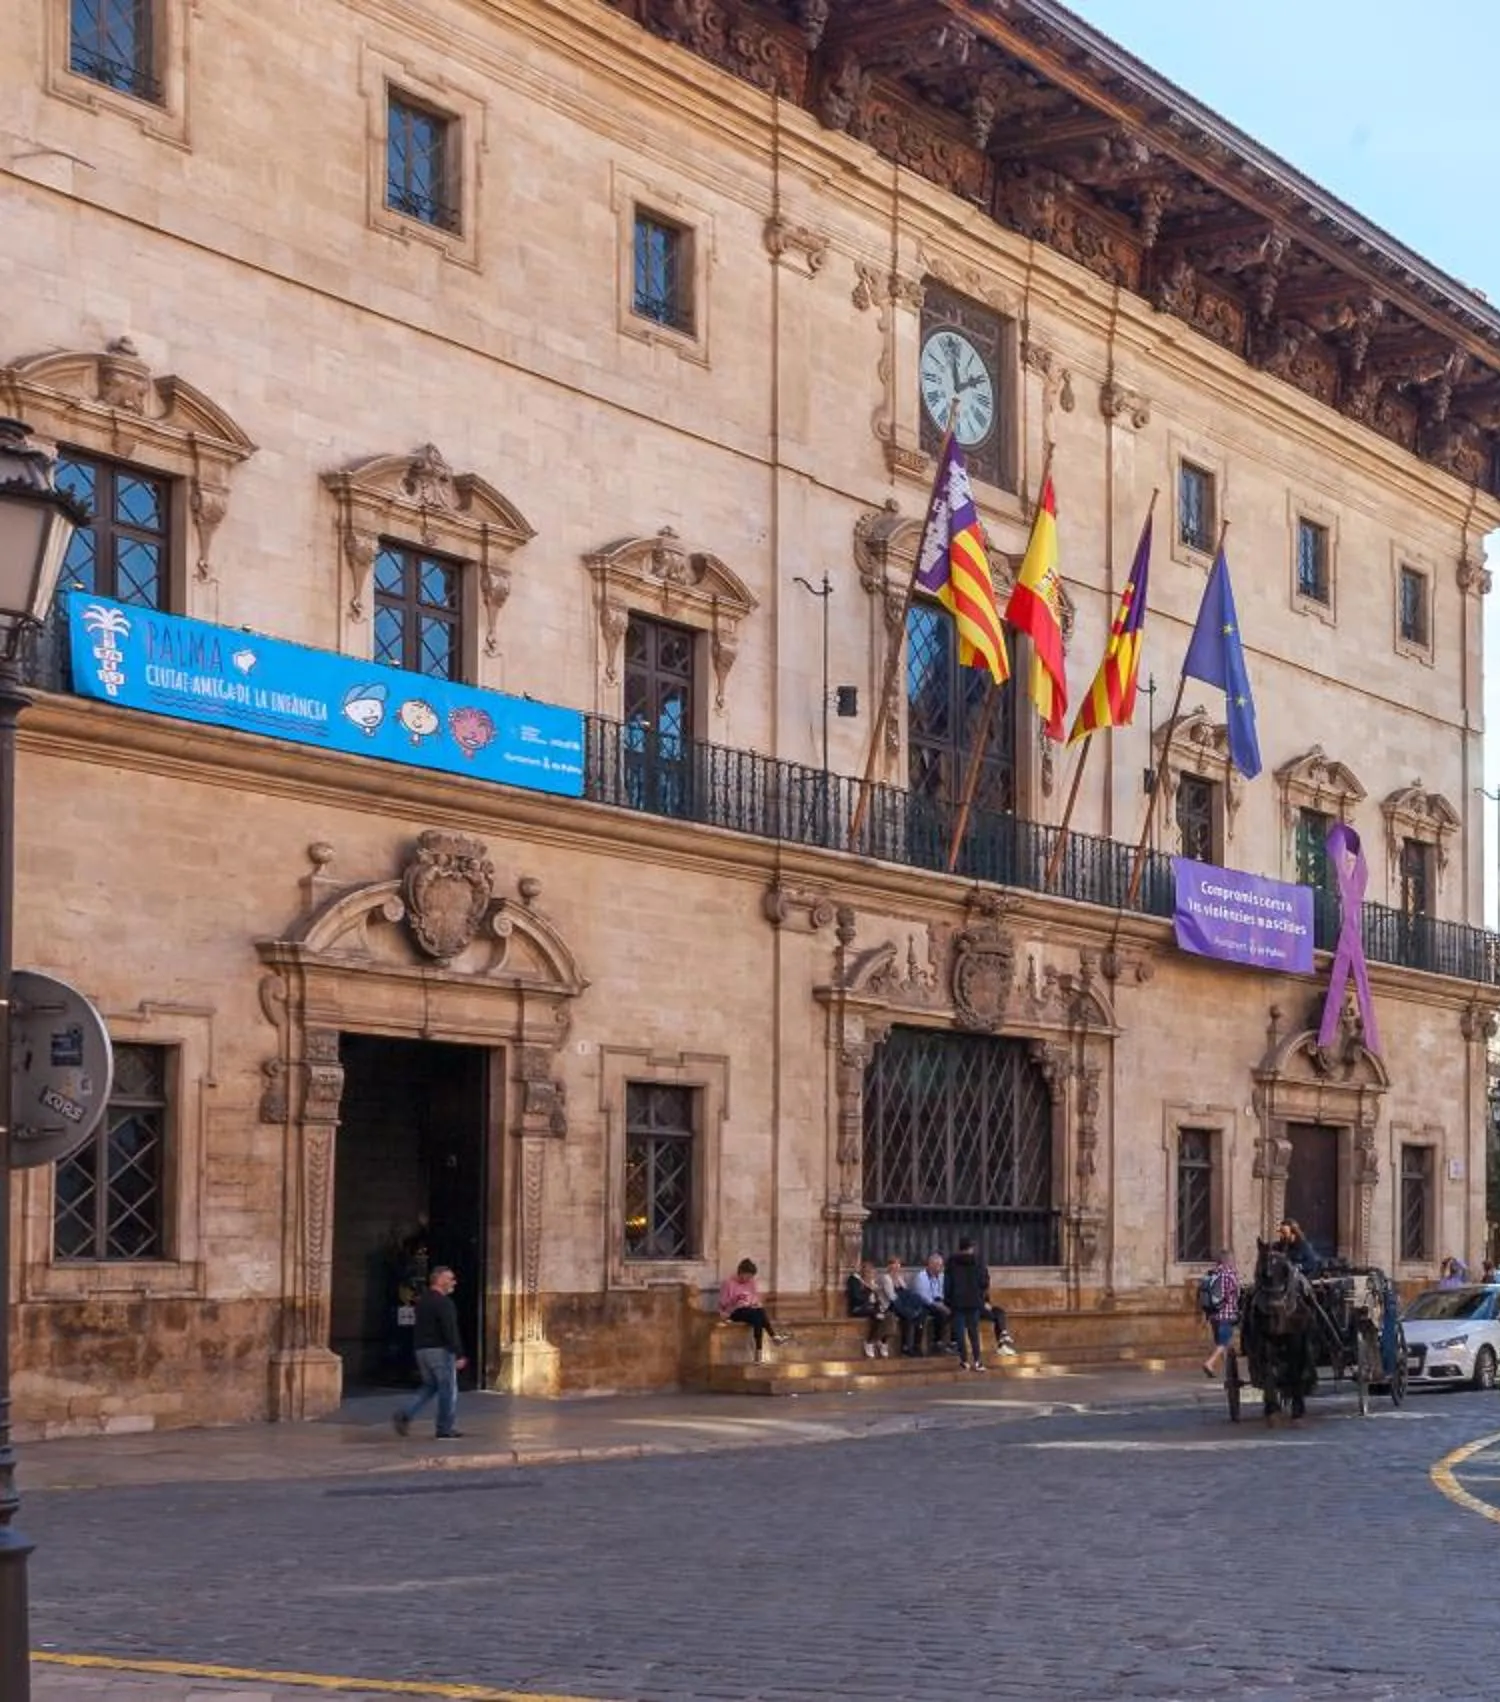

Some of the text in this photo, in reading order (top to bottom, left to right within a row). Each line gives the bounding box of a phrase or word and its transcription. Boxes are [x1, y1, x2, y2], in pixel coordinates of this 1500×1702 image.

[146, 621, 224, 673] PALMA
[145, 664, 189, 693] CIUTAT
[191, 675, 236, 701] AMIGA
[255, 688, 271, 709] LA
